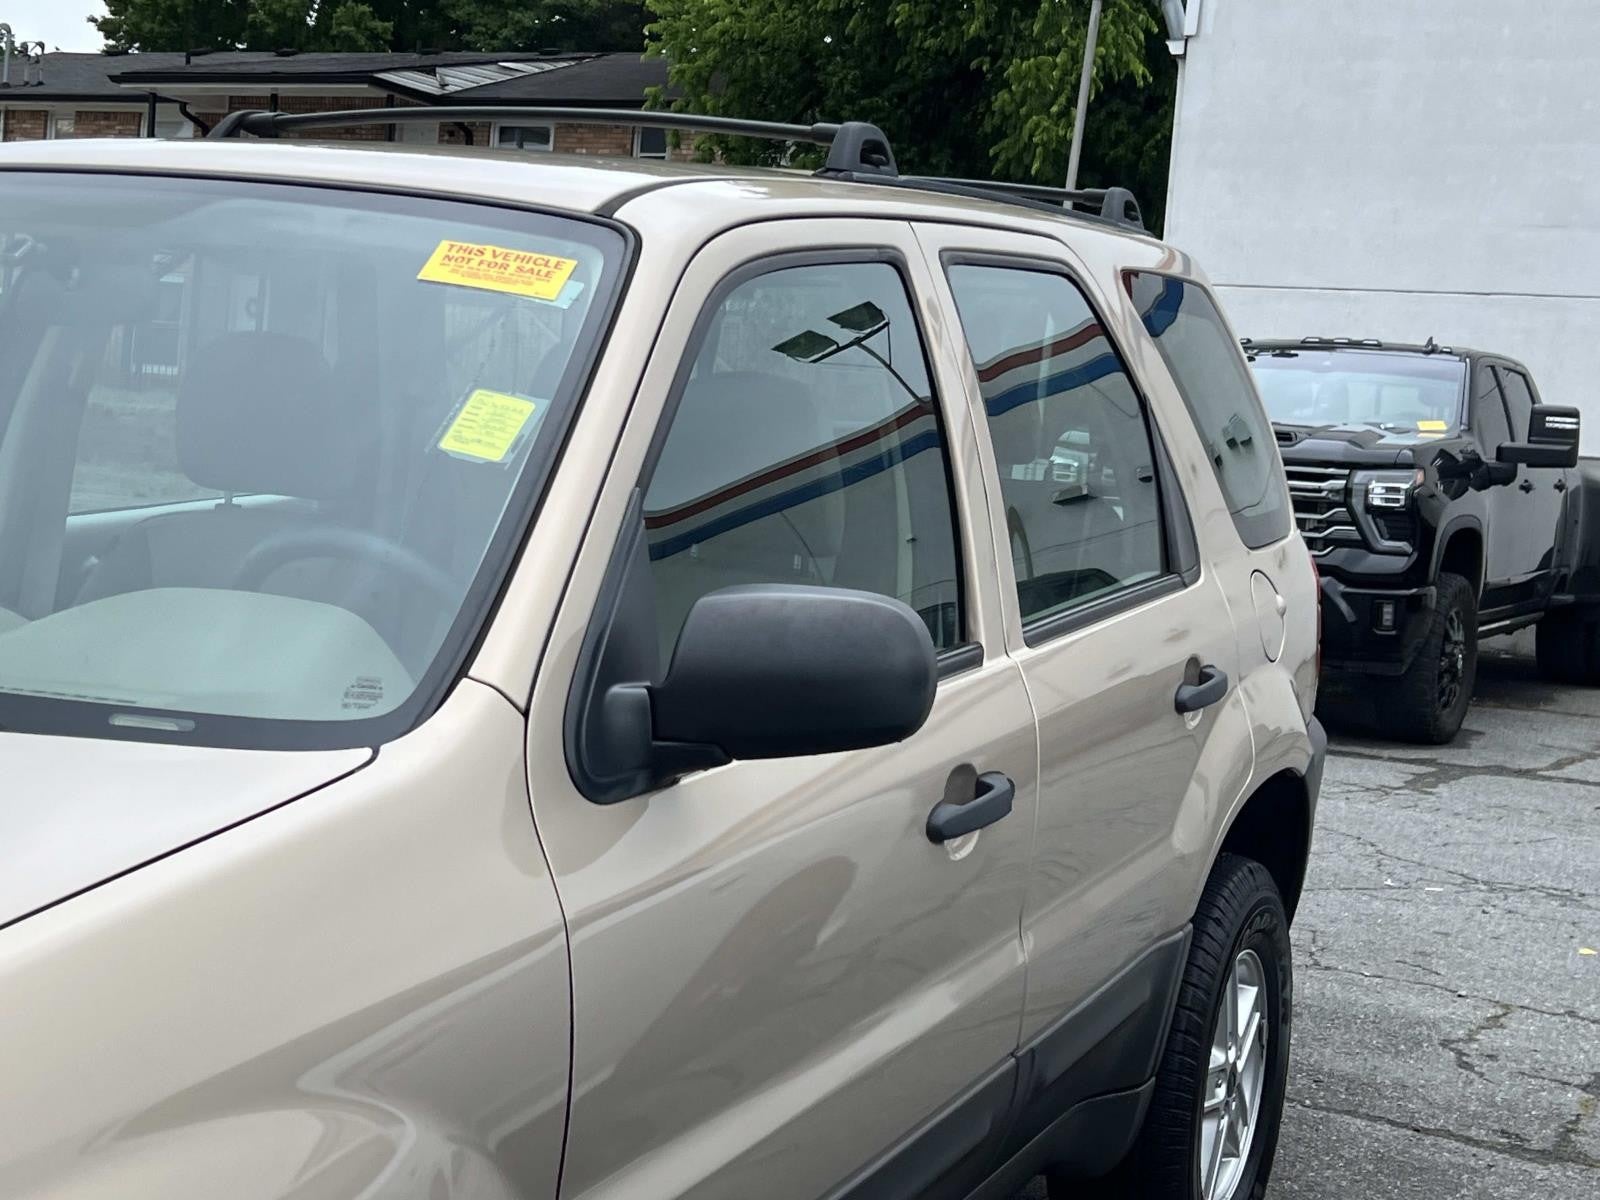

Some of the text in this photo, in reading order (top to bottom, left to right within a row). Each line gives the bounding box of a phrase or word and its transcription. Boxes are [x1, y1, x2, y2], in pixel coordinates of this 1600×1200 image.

[442, 254, 474, 265] NOT
[478, 259, 510, 271] FOR
[515, 266, 556, 279] SALE
[447, 243, 567, 270] THIS VEHICLE
